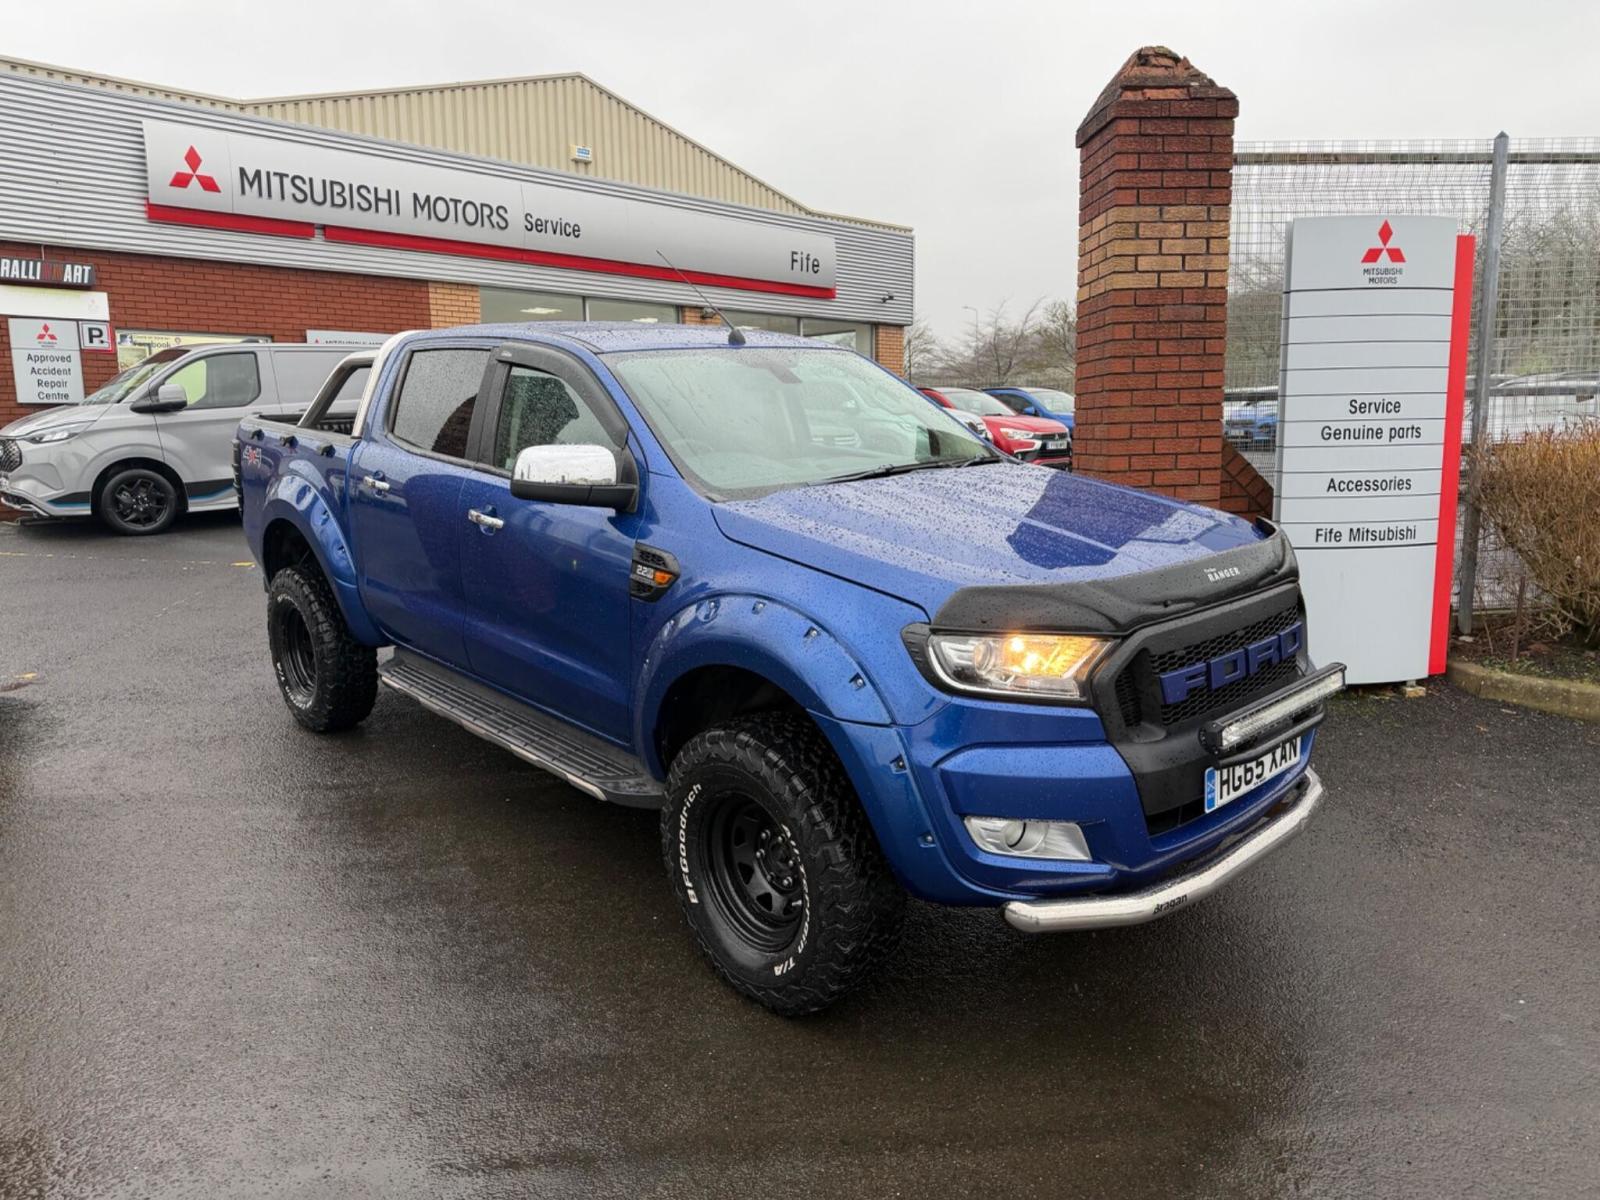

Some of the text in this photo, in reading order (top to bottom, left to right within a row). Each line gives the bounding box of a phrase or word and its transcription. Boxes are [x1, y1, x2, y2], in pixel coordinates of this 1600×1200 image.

[238, 166, 820, 275] MITSUBISHI MOTORS Service Fife
[1362, 268, 1403, 276] MITSUBISHI
[1368, 276, 1398, 284] MOTORS
[26, 353, 72, 364] Approved
[30, 367, 71, 376] Accident
[37, 379, 68, 389] Repair
[37, 391, 70, 401] Centre
[1349, 398, 1401, 416] Service
[1320, 424, 1422, 443] Genuine parts
[1327, 476, 1412, 493] Accessories
[1315, 525, 1417, 543] Fife Mitsubishi
[1207, 566, 1241, 583] RANGER
[1159, 621, 1302, 705] FORD
[1219, 738, 1298, 801] HG65 XAN
[679, 783, 702, 904] BFGoodrich
